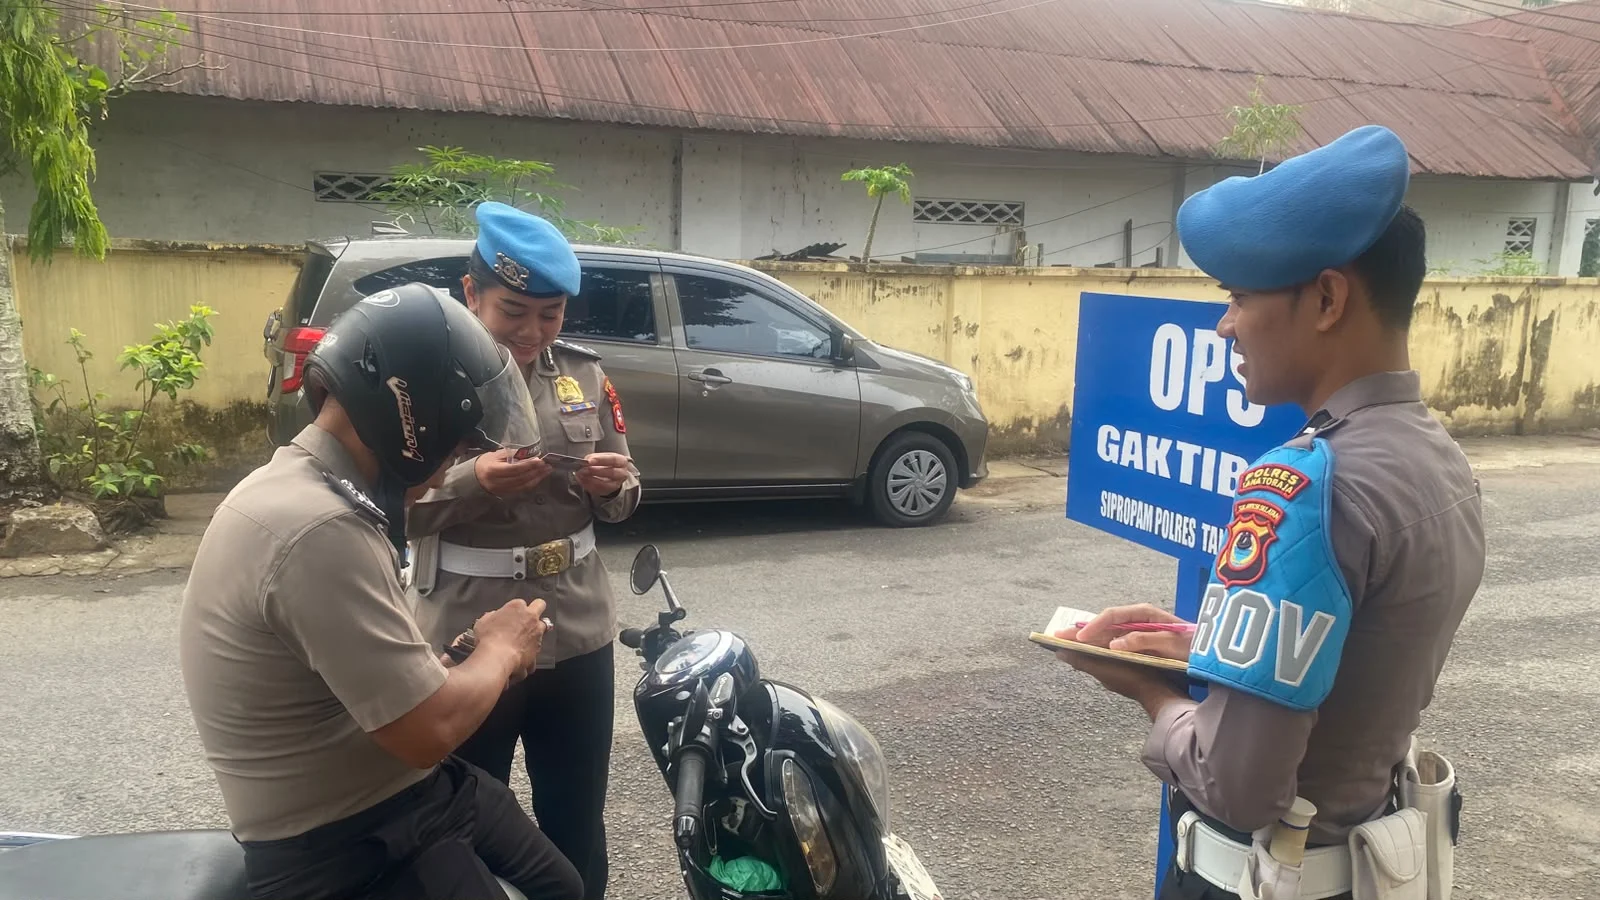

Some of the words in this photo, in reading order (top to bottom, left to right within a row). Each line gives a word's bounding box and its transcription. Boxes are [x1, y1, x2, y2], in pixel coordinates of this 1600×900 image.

[1245, 467, 1299, 486] POLRES
[1262, 477, 1294, 494] TORAJA
[1100, 490, 1154, 533] SIPROPAM
[1154, 506, 1197, 549] POLRES
